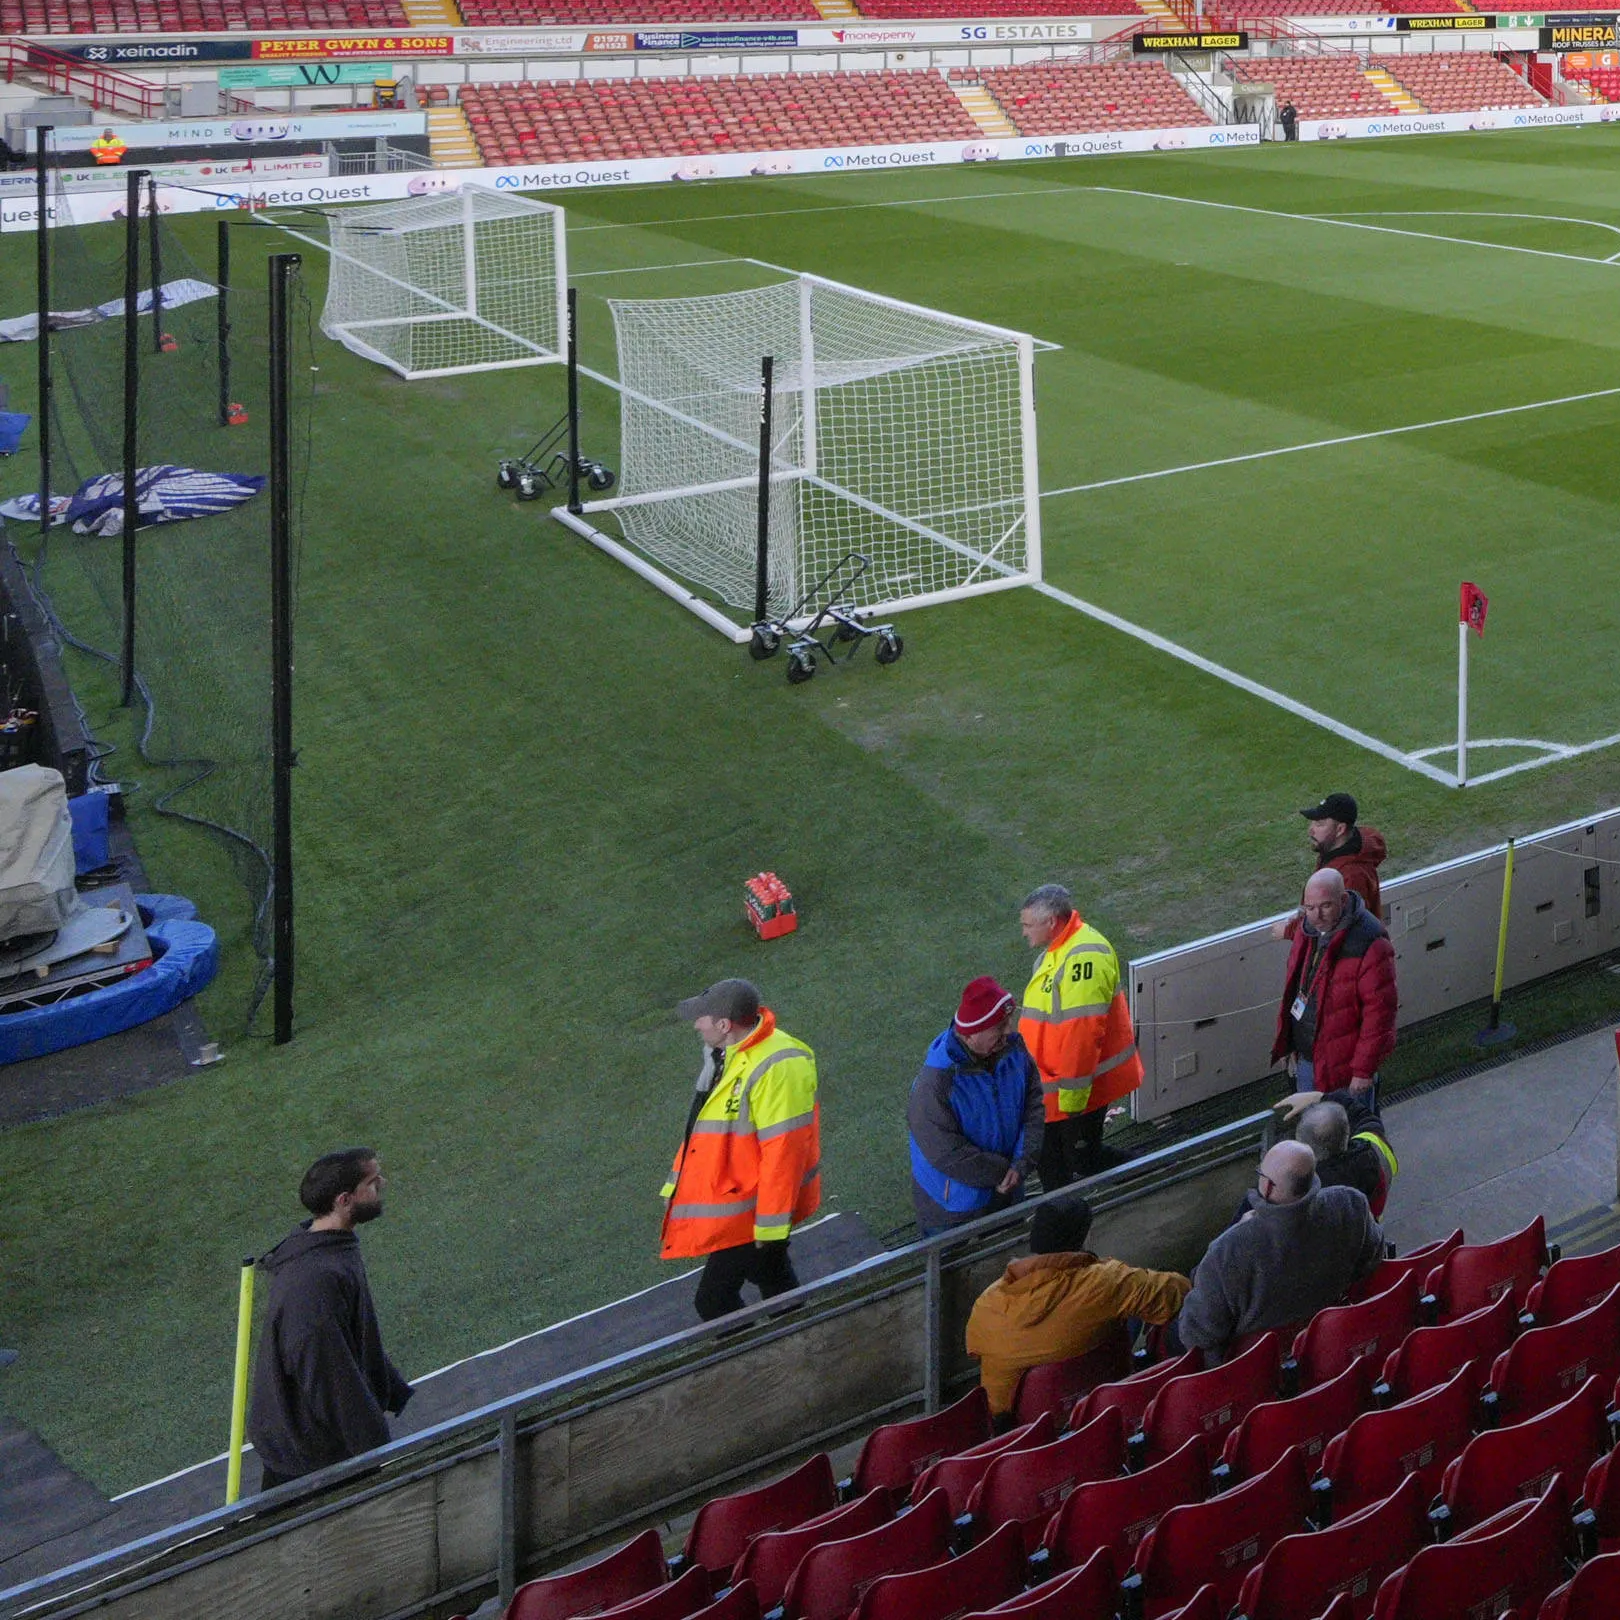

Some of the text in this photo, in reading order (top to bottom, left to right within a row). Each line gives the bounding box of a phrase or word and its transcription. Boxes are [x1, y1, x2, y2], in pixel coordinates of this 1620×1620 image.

[1408, 18, 1484, 28] WREXHAM LAGER
[638, 33, 680, 41] Business
[844, 30, 916, 43] moneypenny
[961, 25, 1078, 40] SG ESTATES
[1552, 27, 1616, 42] MINERA
[260, 37, 449, 52] PETER GWYN & SONS
[643, 38, 680, 46] Finance
[1142, 37, 1238, 48] WREXHAM LAGER
[116, 44, 198, 58] xeinadin
[1602, 54, 1611, 65] G
[1528, 113, 1584, 124] Meta Quest
[169, 128, 214, 138] MIND
[1383, 121, 1446, 133] Meta Quest
[1226, 132, 1258, 143] Meta
[1044, 139, 1123, 154] Mta Quest
[846, 150, 936, 166] Meta Quest
[263, 160, 323, 172] LIMITED
[523, 169, 631, 186] Meta Quest
[247, 184, 371, 204] Meta Quest
[1071, 961, 1093, 982] 30
